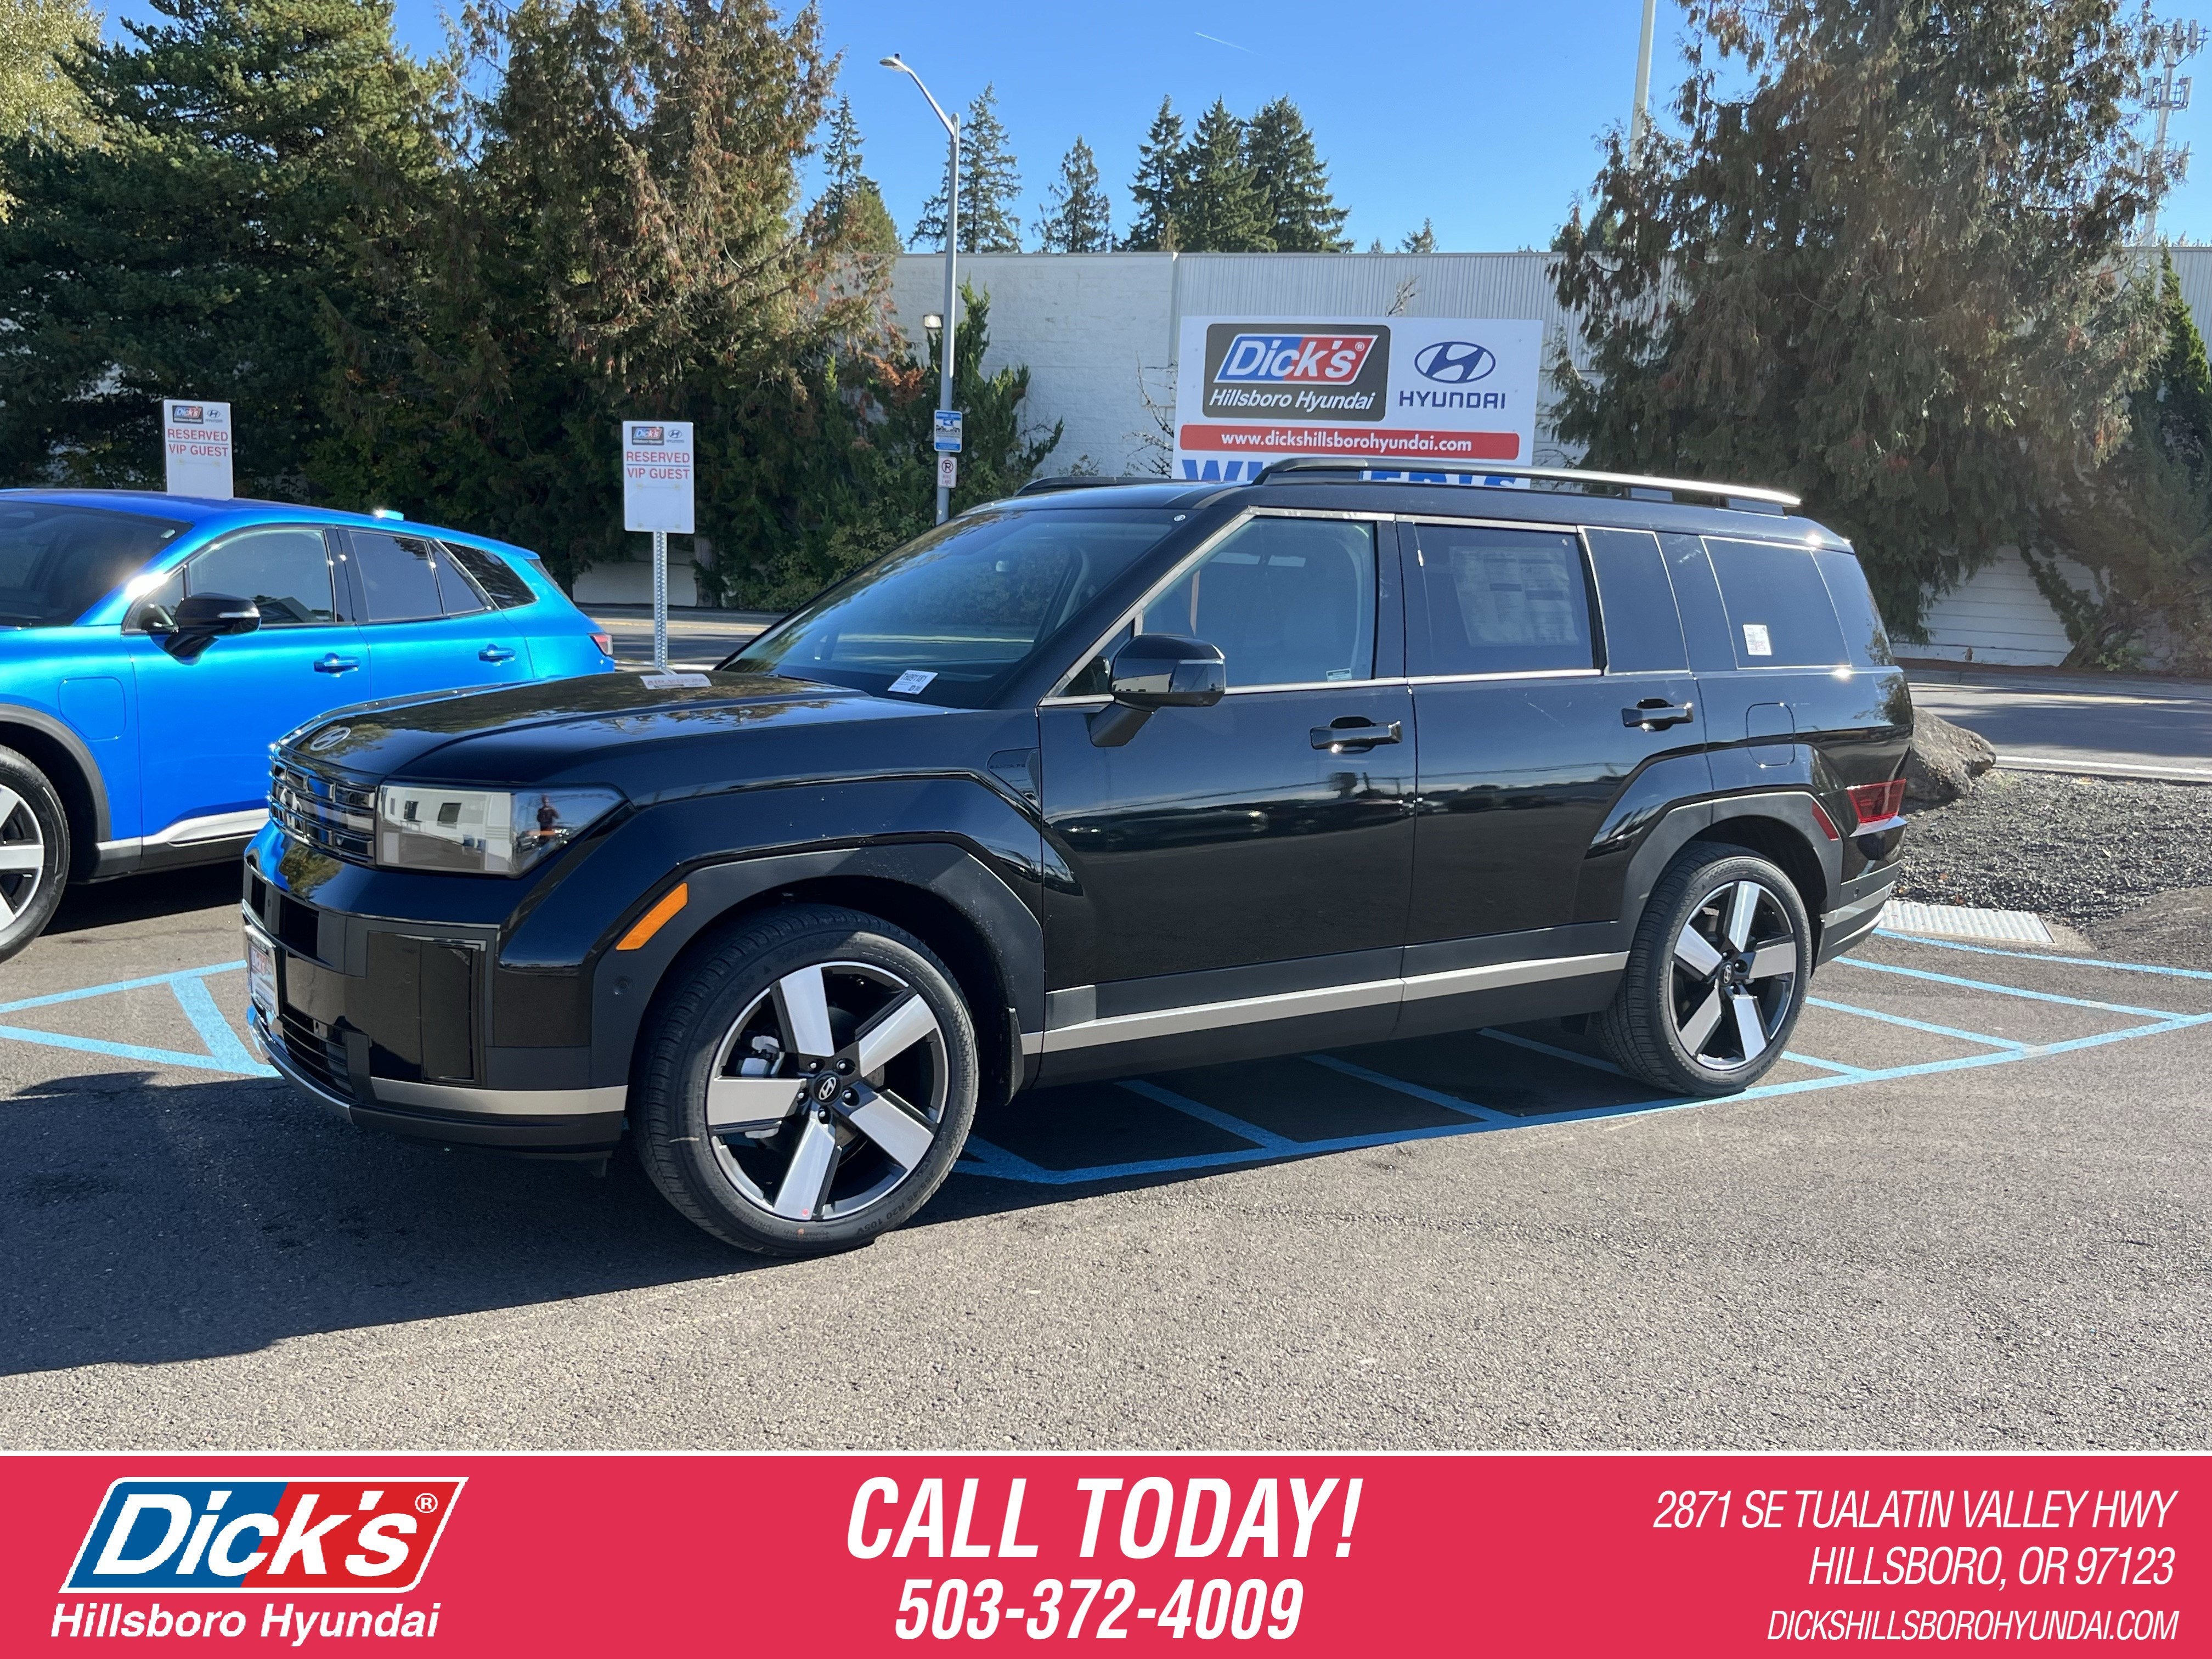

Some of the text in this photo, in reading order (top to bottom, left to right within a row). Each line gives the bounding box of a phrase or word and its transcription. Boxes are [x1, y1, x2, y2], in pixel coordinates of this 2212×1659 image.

[1228, 340, 1357, 378] Dick's
[1209, 389, 1375, 413] Hillsboro Hyundai
[1400, 390, 1505, 409] HYUNDAI
[168, 428, 228, 442] RESERVED
[1221, 431, 1472, 453] www.dickshillsborohyundai.com
[169, 444, 228, 457] VIP GUEST
[627, 452, 690, 463] RESERVED
[627, 467, 690, 479] VIP GUEST
